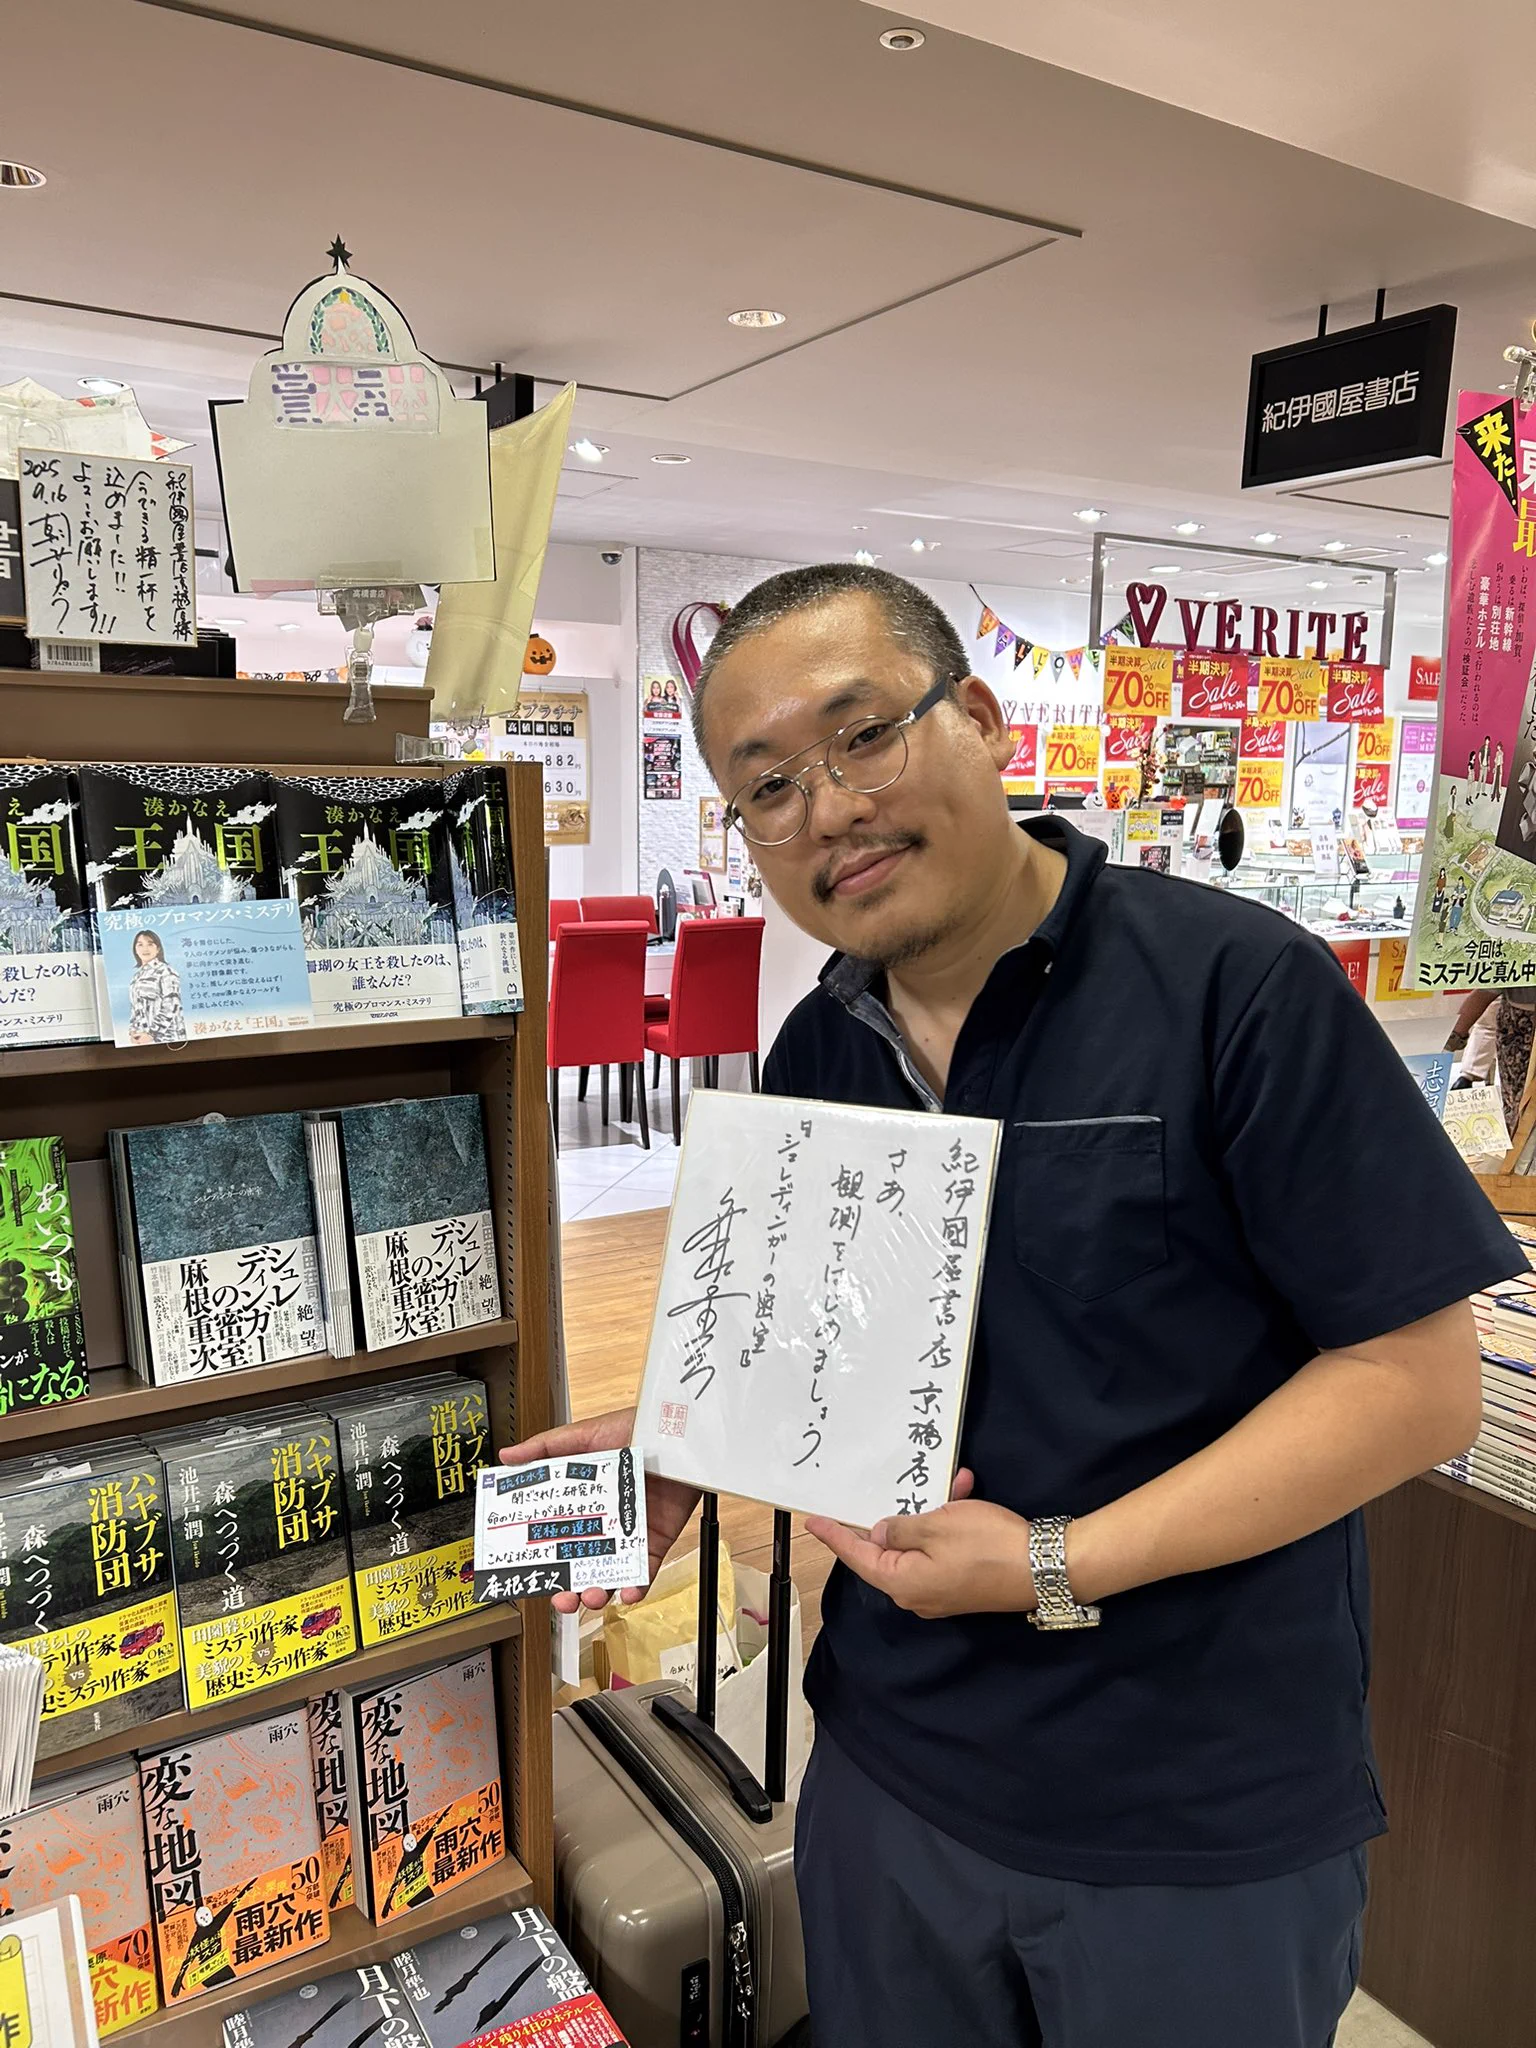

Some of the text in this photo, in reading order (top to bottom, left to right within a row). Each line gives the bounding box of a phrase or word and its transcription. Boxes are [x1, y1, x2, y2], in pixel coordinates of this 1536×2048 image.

[1262, 371, 1419, 433] 紀伊國屋書店
[23, 459, 61, 478] 2025
[1473, 411, 1517, 506] 来た!
[1187, 660, 1230, 676] 半期決算
[1189, 666, 1240, 709] Sale
[1332, 670, 1369, 684] 半期決算
[1143, 690, 1169, 708] OFF
[1293, 699, 1316, 714] OFF
[1333, 674, 1378, 714] Sale
[1244, 727, 1280, 752] Sale
[1077, 757, 1097, 771] OFF
[8, 797, 25, 816] え
[143, 796, 231, 818] 湊かなえ
[1262, 791, 1280, 802] OFF
[1354, 773, 1386, 802] Sale
[324, 804, 402, 824] 湊かなえ
[6, 822, 64, 875] 国
[114, 822, 264, 874] 王国
[103, 902, 295, 932] 究極のブロマンス・ミステリ
[1464, 939, 1507, 959] 今回は、
[352, 974, 412, 991] 誰なんだ?
[1418, 959, 1536, 986] ミステリど真ん中
[333, 997, 432, 1013] 究極のブロマンス・ミステリ
[876, 1149, 908, 1217] さあ、
[431, 1218, 462, 1329] ディンガー
[918, 1137, 980, 1370] 紀伊國屋書店
[236, 1245, 276, 1362] ディンガー
[385, 1231, 419, 1342] 麻根重次
[411, 1256, 442, 1335] の密室
[179, 1259, 220, 1376] 麻根重次
[212, 1285, 249, 1371] の密室
[350, 1423, 373, 1492] 池井戸潤
[430, 1401, 465, 1500] 消防団
[178, 1466, 204, 1541] 池井戸潤
[271, 1442, 310, 1550] 消防団
[305, 1435, 339, 1538] ハヤブサ
[379, 1435, 412, 1559] 森へつづく道
[88, 1481, 133, 1598] 消防団
[126, 1472, 164, 1583] ハヤブサ
[212, 1481, 246, 1612] 森へつづく道
[531, 1519, 601, 1539] 究極の選択
[365, 1554, 437, 1587] 田園暮らしの
[487, 1545, 555, 1565] こんな状況で
[559, 1543, 613, 1558] 密室殺人
[20, 1523, 53, 1633] 森へつづく
[375, 1561, 458, 1602] ミステリ作家
[421, 1588, 436, 1601] VS
[192, 1608, 276, 1645] 田園暮らしの
[203, 1615, 299, 1661] ミステリ作家
[196, 1655, 244, 1681] 美貌の
[205, 1641, 328, 1700] 歴史ミステリ作家
[256, 1647, 270, 1659] VS
[462, 1661, 487, 1683] 雨穴
[69, 1669, 85, 1681] VS
[268, 1722, 300, 1745] 雨穴
[362, 1692, 410, 1853] 変な地図
[97, 1789, 131, 1814] 雨穴
[477, 1782, 501, 1815] 50
[142, 1752, 203, 1924] 変な地図
[434, 1816, 482, 1859] 雨穴
[291, 1857, 321, 1891] 50
[431, 1829, 502, 1887] 最新作
[234, 1892, 296, 1937] 雨穴
[117, 1929, 149, 1963] 70
[232, 1909, 323, 1967] 最新作
